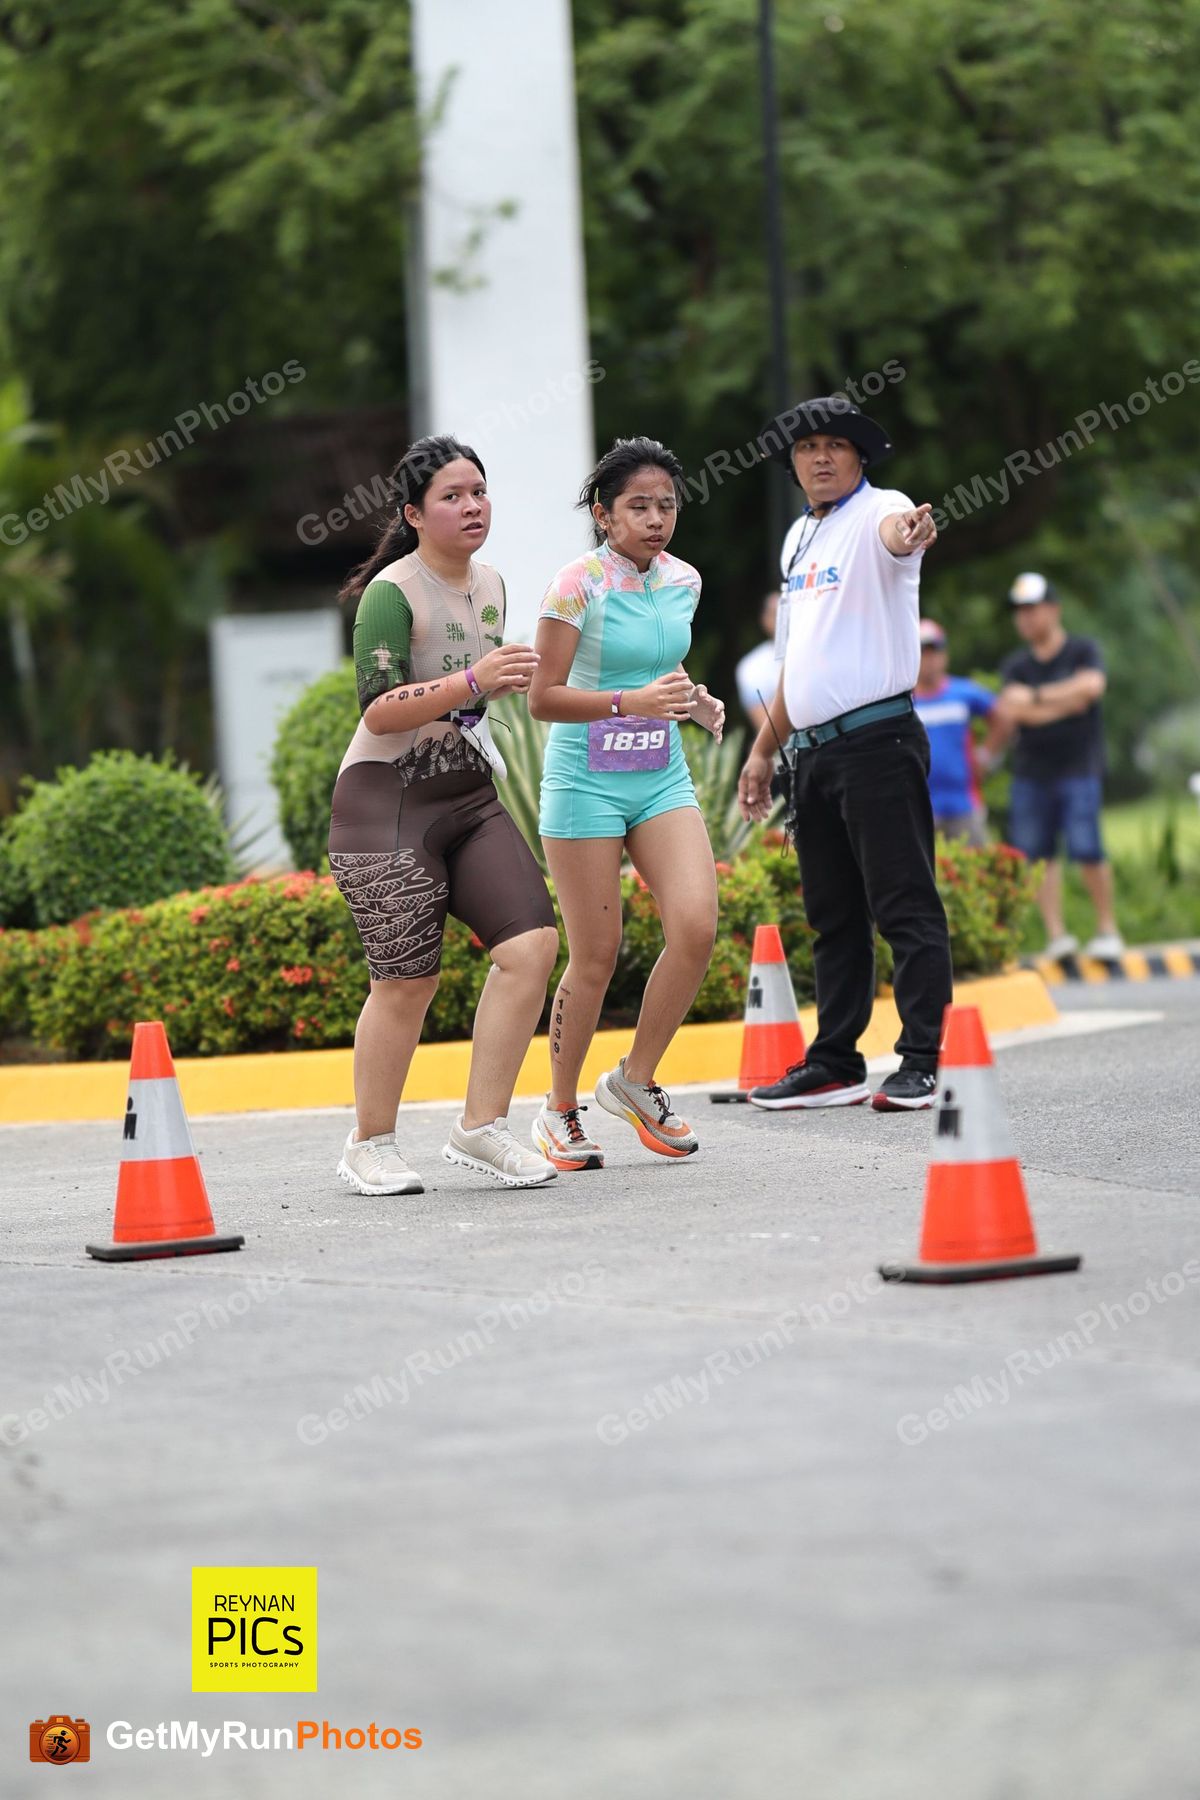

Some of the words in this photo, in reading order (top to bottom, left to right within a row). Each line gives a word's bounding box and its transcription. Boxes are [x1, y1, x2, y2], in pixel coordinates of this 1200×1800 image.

[442, 653, 472, 672] S+F
[602, 729, 666, 751] 1839
[554, 999, 564, 1053] 1839
